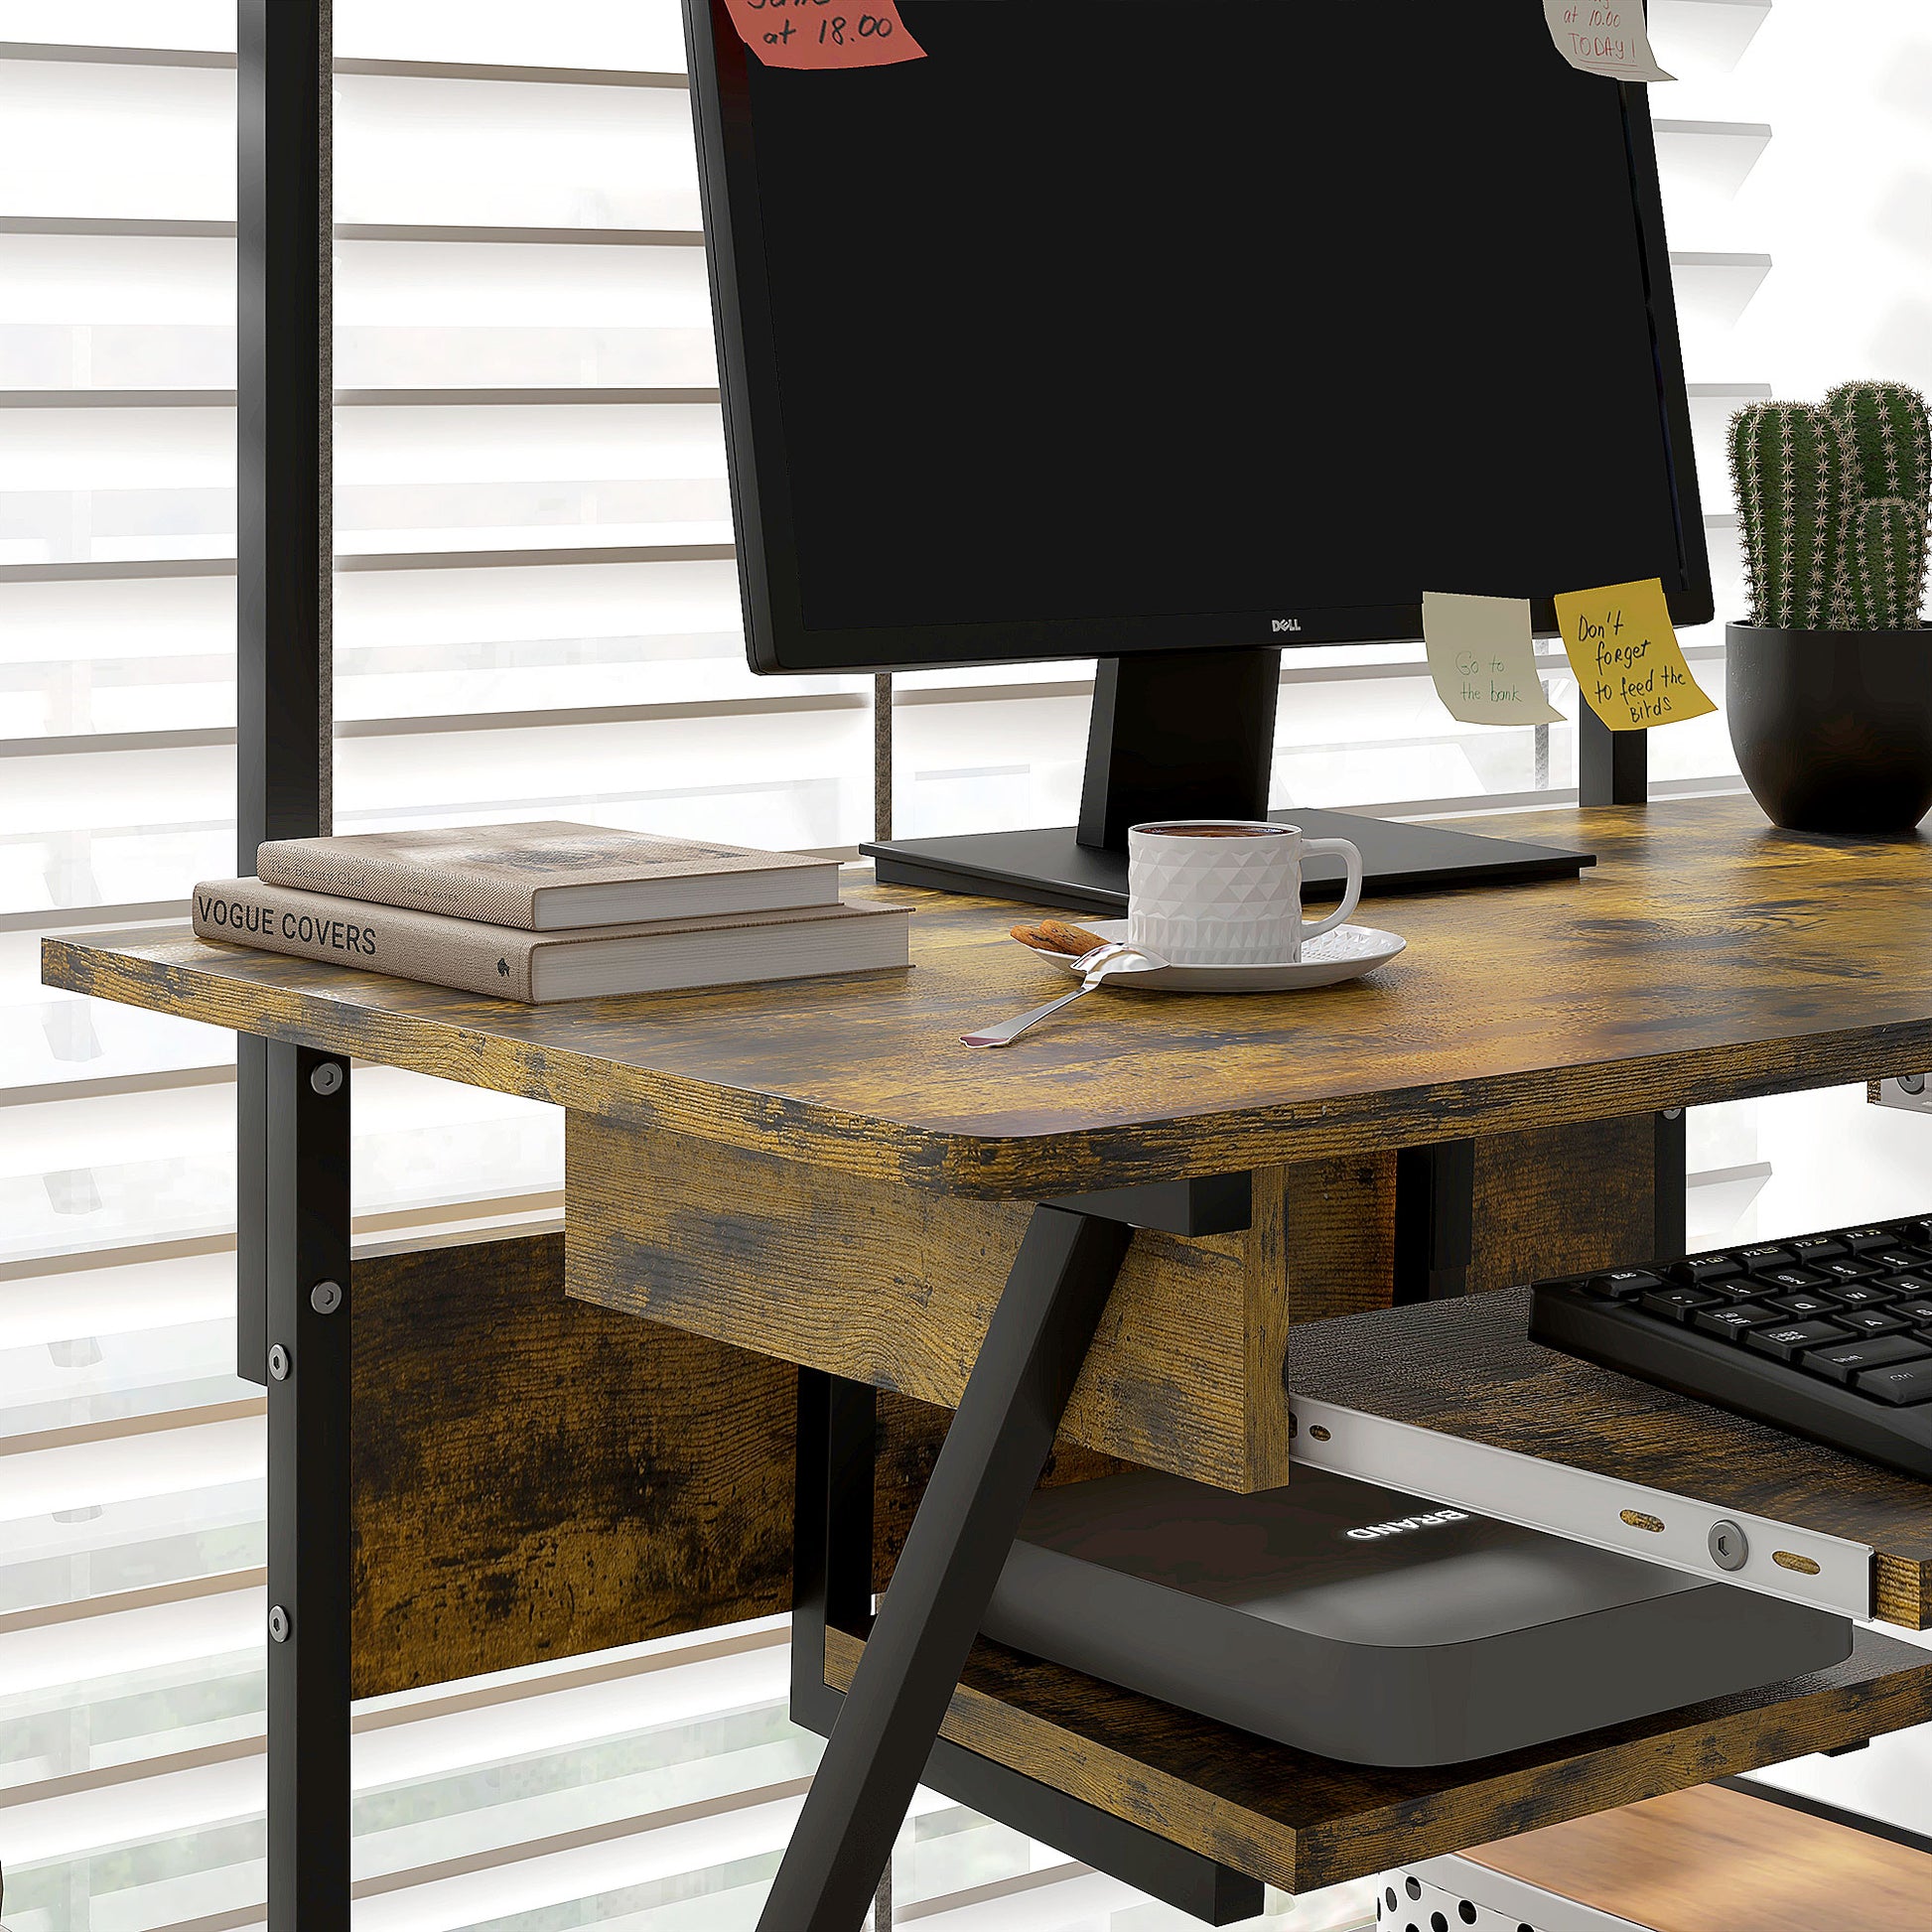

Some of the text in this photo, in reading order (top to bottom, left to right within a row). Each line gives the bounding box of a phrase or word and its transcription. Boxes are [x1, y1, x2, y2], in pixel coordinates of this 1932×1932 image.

[762, 14, 893, 46] at 18.00
[1564, 5, 1621, 28] at 10.00
[1271, 619, 1302, 632] DELL
[1579, 610, 1624, 642] Don't
[1455, 650, 1505, 676] Go to
[1595, 639, 1651, 676] forget
[1460, 679, 1523, 703] the bank
[1594, 665, 1687, 706] to feed the
[199, 896, 376, 955] VOGUE COVERS
[1889, 1371, 1914, 1381] Ctrl
[1346, 1509, 1469, 1539] BRAND
